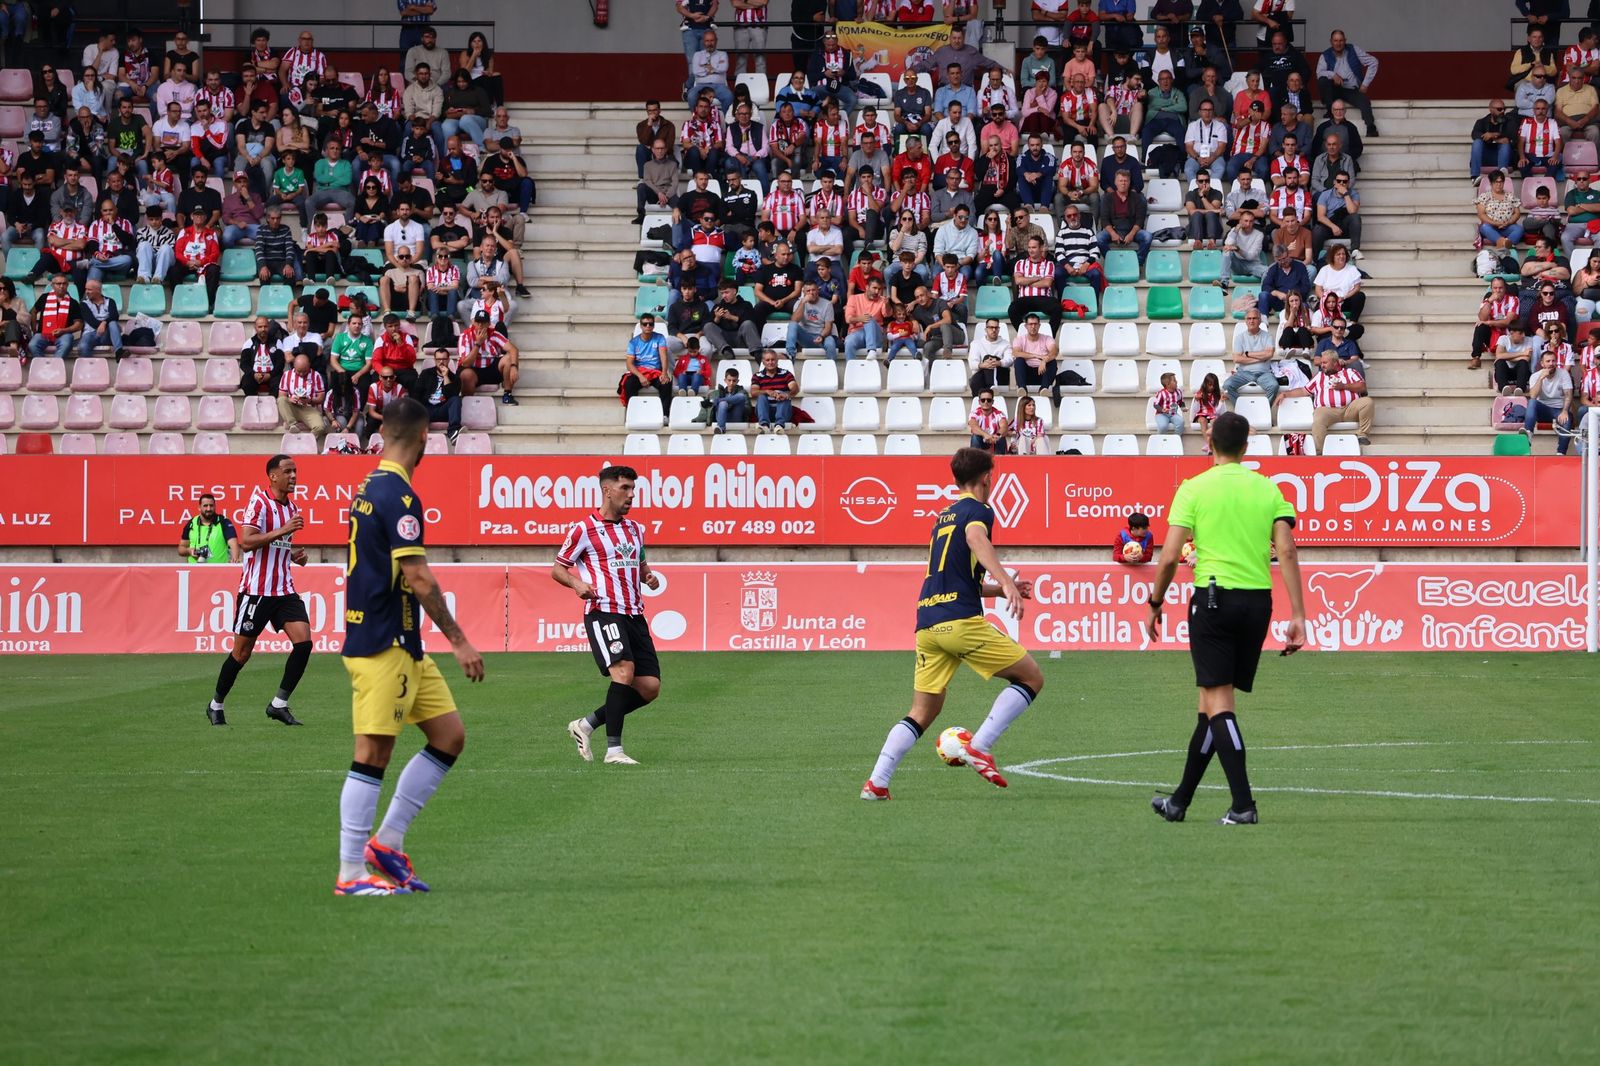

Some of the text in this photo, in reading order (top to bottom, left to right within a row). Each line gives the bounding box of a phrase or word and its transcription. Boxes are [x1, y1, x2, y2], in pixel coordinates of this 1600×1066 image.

[838, 26, 949, 42] KOMANDO LAGUNERO
[704, 460, 817, 509] Atilano
[1064, 483, 1113, 502] Grupo
[839, 496, 898, 505] NISSAN
[1065, 500, 1165, 518] Leomotor
[12, 513, 51, 525] LUZ
[480, 520, 518, 535] Pza.
[651, 520, 663, 535] 7
[702, 520, 736, 535] 607
[741, 520, 776, 535] 489
[781, 520, 815, 535] 002
[1364, 518, 1373, 531] Y
[1382, 518, 1492, 532] JAMONES
[1033, 573, 1112, 605] Carné
[782, 614, 866, 630] Junta de
[1033, 611, 1132, 644] Castilla
[602, 622, 621, 642] 10
[193, 635, 215, 652] El
[314, 635, 340, 652] de
[728, 633, 866, 652] Castilla y León
[396, 673, 408, 699] 3
